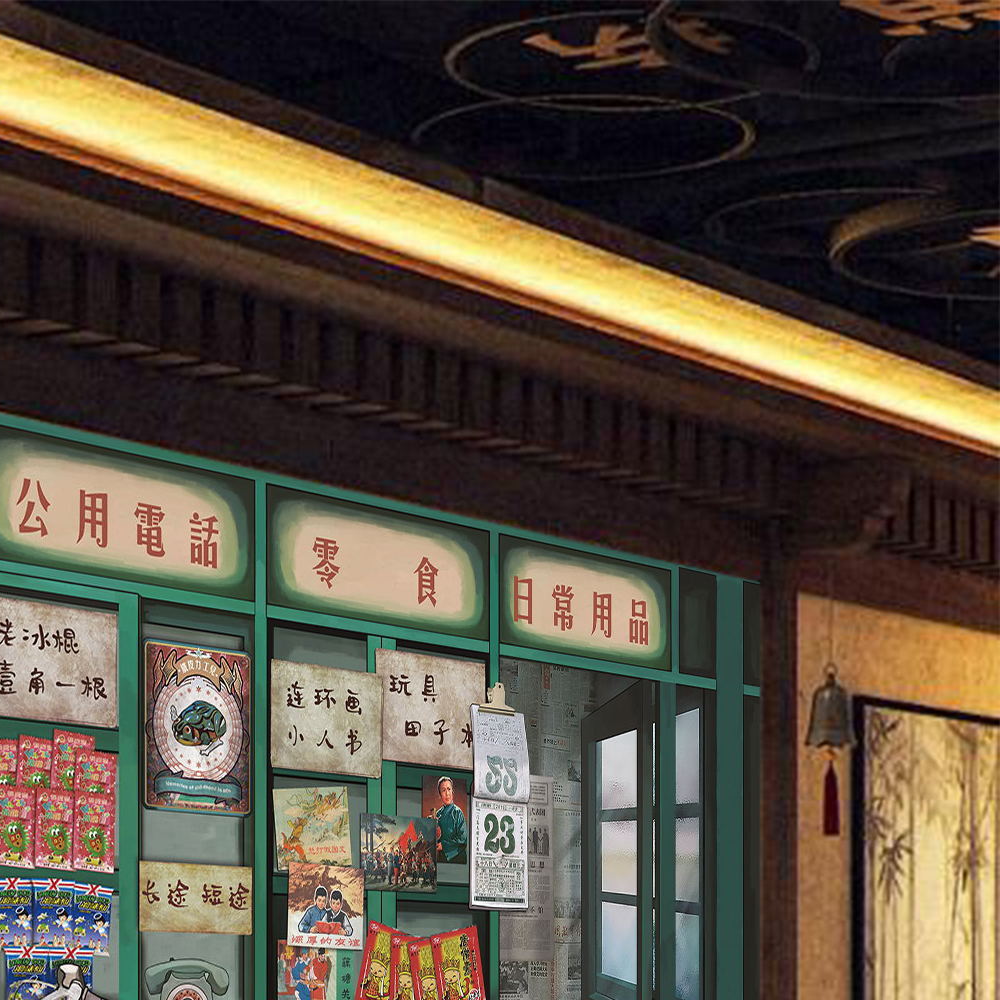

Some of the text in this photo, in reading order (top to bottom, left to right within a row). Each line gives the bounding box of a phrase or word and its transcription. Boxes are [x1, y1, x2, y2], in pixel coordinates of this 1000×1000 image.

[16, 478, 219, 569] 公用電話
[312, 537, 440, 609] 零食
[512, 576, 650, 646] 日常用品
[286, 680, 363, 715] 连环画
[389, 673, 438, 703] 玩具
[288, 724, 363, 755] 小人书
[484, 813, 516, 855] 23
[142, 879, 190, 908] 长途
[202, 882, 250, 911] 短途
